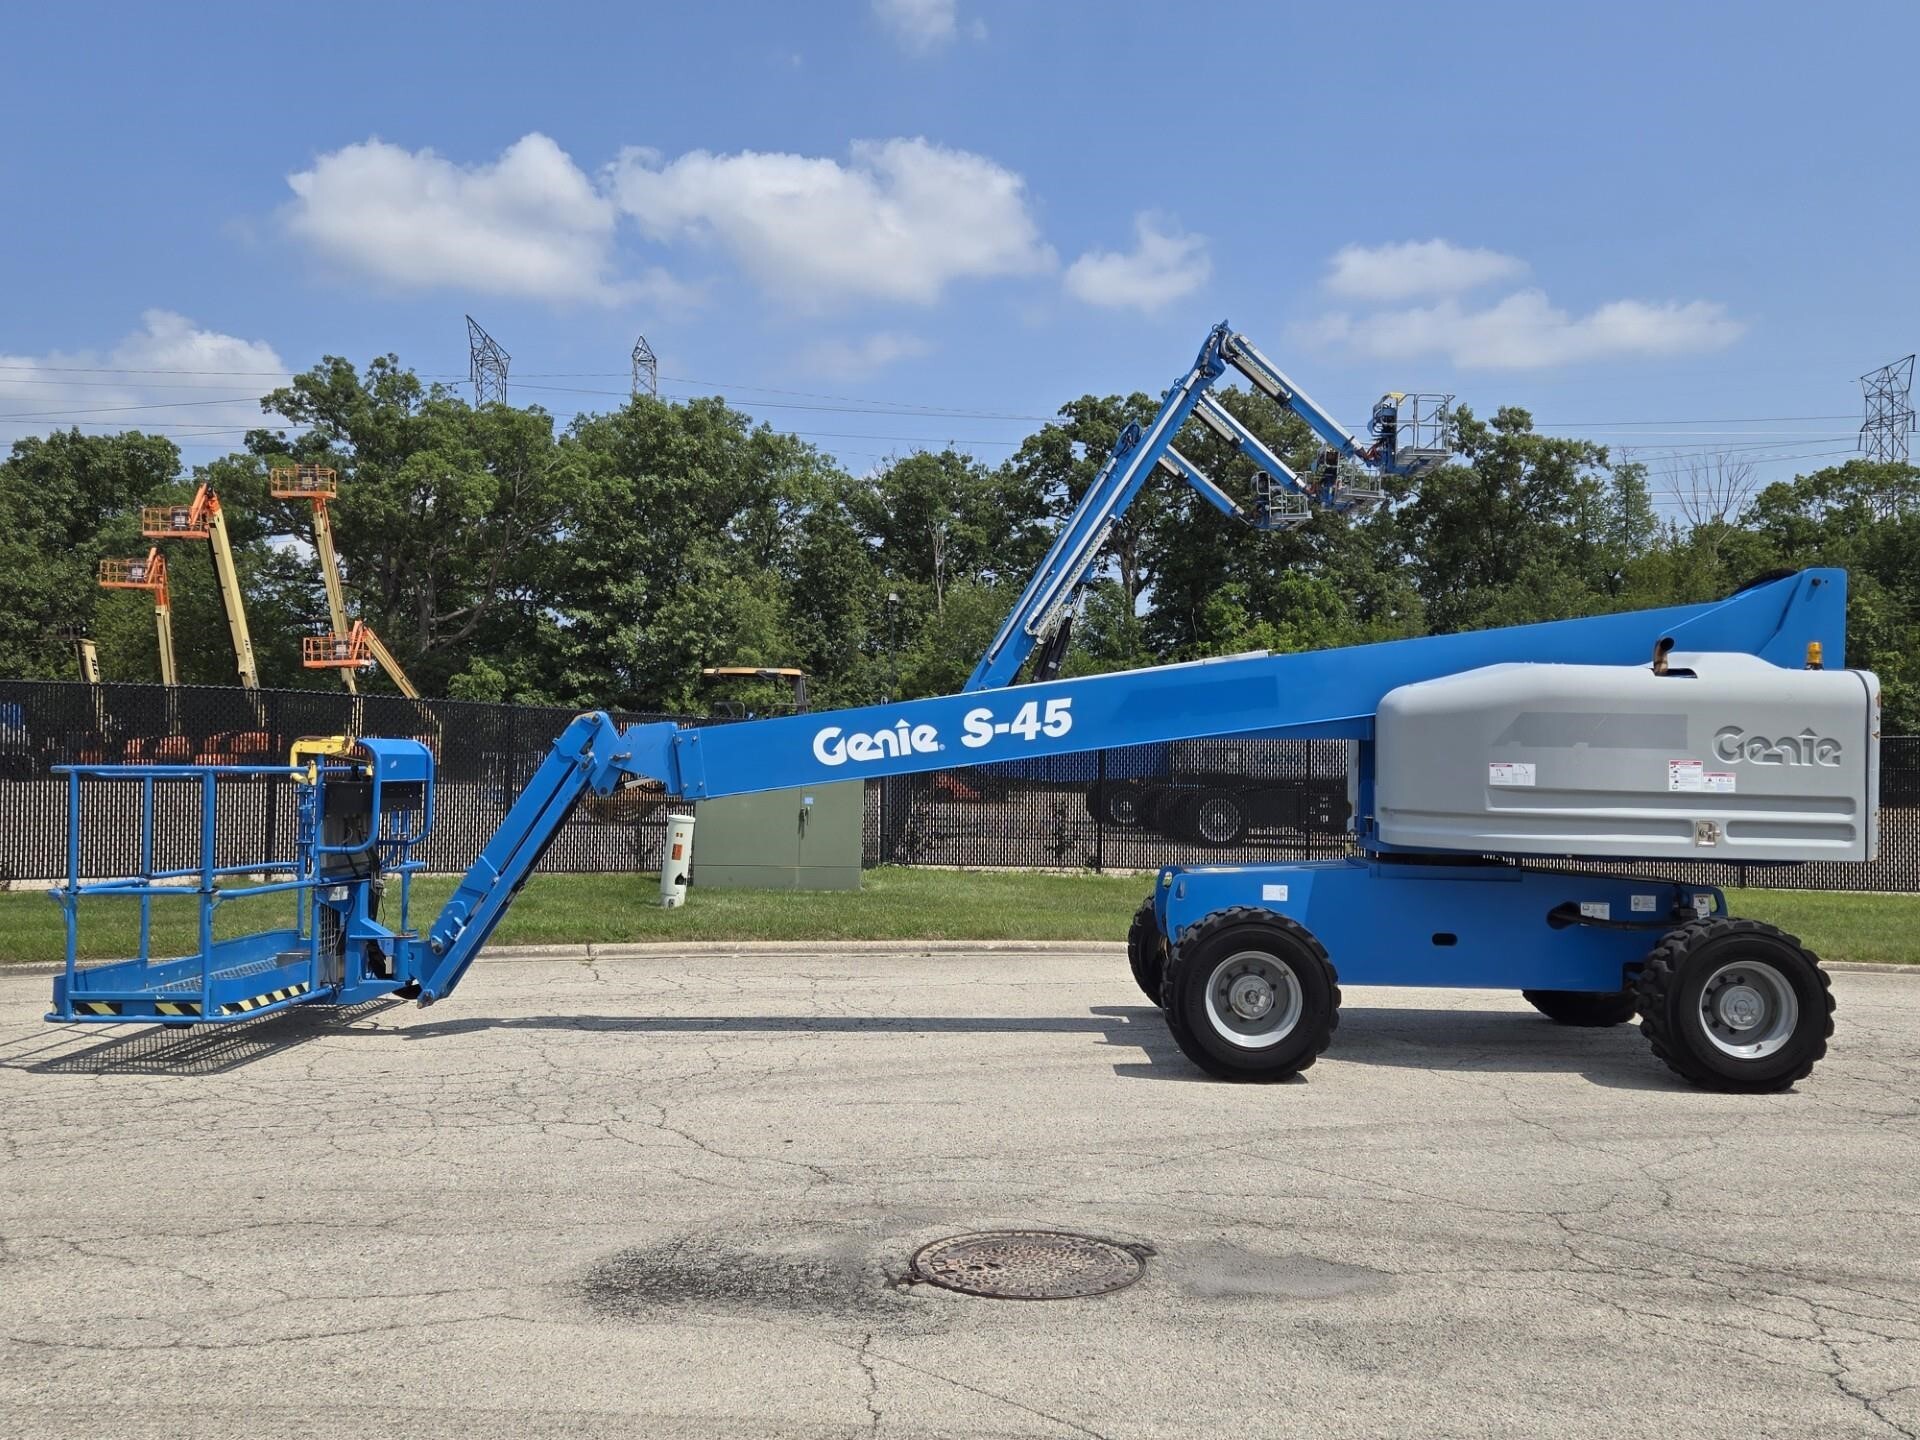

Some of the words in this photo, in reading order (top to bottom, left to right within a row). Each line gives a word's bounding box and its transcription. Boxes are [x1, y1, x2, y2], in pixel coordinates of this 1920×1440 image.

[90, 656, 98, 676] JLG
[813, 718, 939, 767] Genie
[960, 698, 1073, 748] S-45
[1711, 725, 1842, 768] Genie
